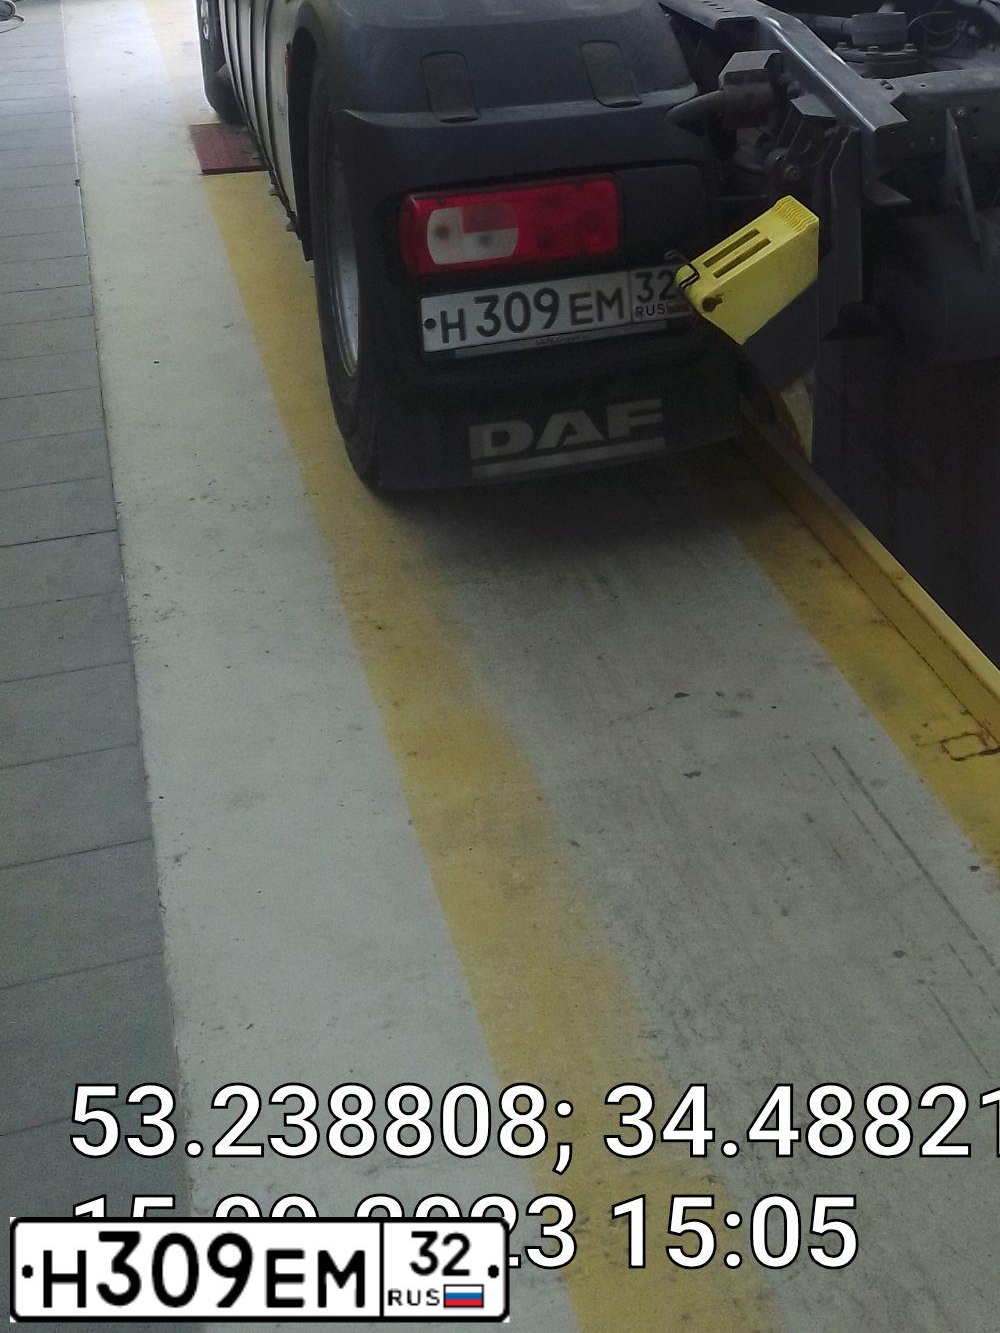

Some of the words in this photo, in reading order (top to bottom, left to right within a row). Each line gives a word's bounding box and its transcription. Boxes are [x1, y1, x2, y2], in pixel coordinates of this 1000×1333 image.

[439, 287, 625, 343] Н309ЕМ
[635, 303, 666, 317] RUS
[468, 398, 664, 460] DAF
